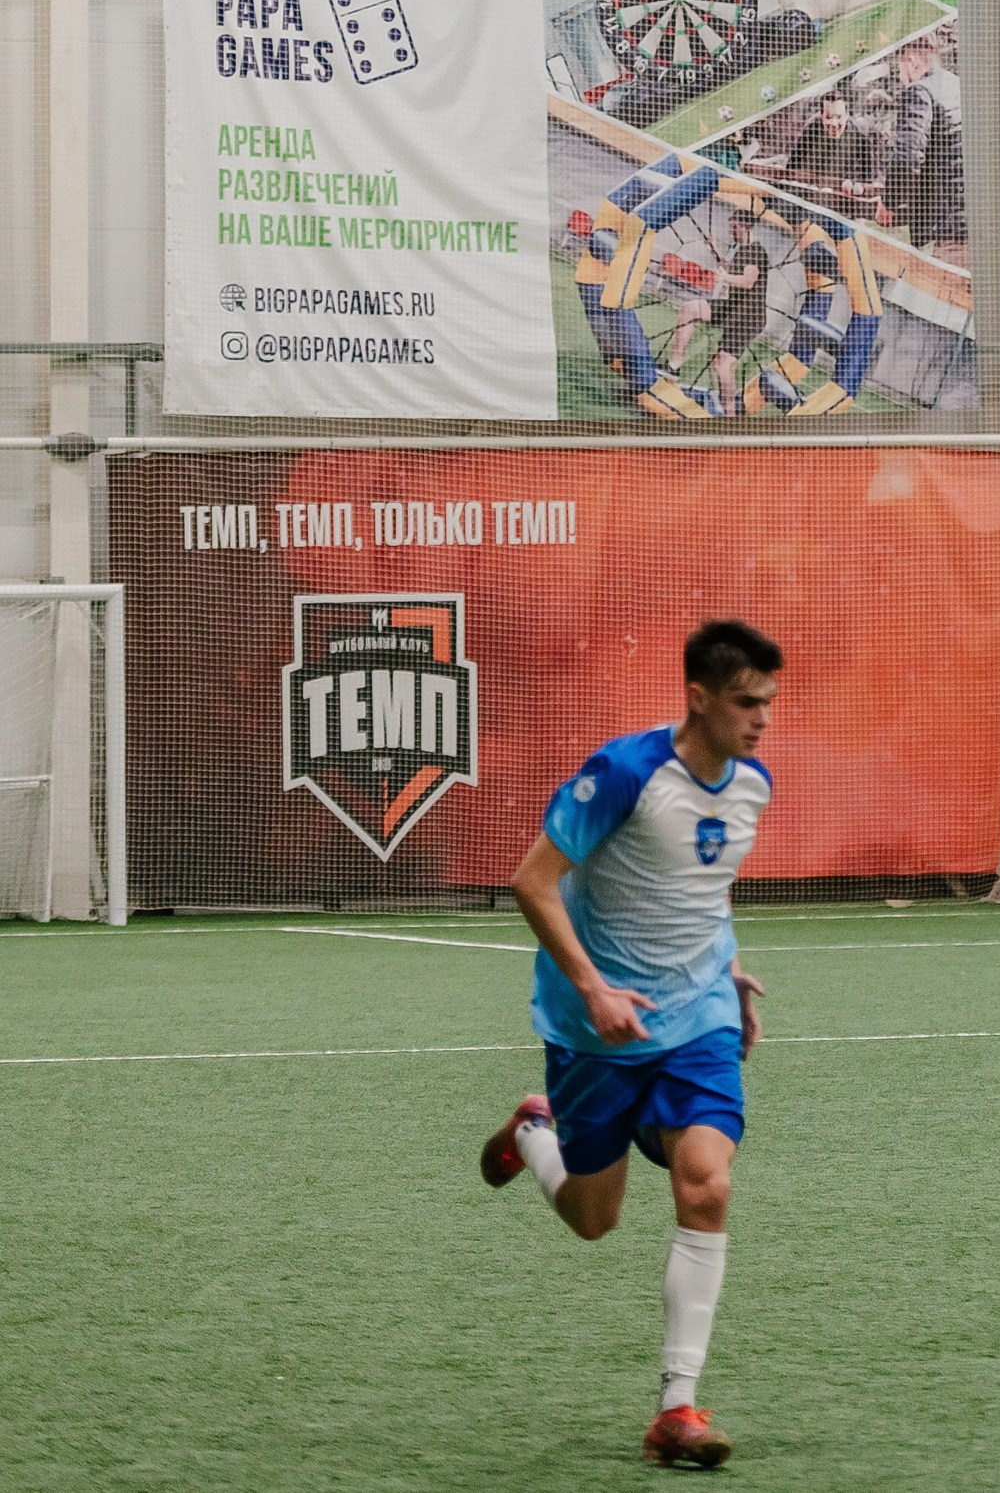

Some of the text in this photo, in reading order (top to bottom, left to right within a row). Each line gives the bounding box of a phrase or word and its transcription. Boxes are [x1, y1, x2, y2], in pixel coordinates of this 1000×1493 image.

[216, 34, 334, 84] GAMES
[216, 124, 317, 162] АРЕНДА
[217, 168, 400, 207] РАЗВЛЕЧЕНИЙ
[217, 212, 520, 254] НА ВАШЕ МЕРОПРИЯТИЕ
[253, 287, 436, 318] BIGPAPAGAMES.RU
[255, 333, 436, 365] @BIGPAPAGAMES
[179, 500, 577, 553] ТЕМП, ТЕМП, ТОЛЬКО ТЕМП!
[303, 670, 458, 759] ТЕМП
